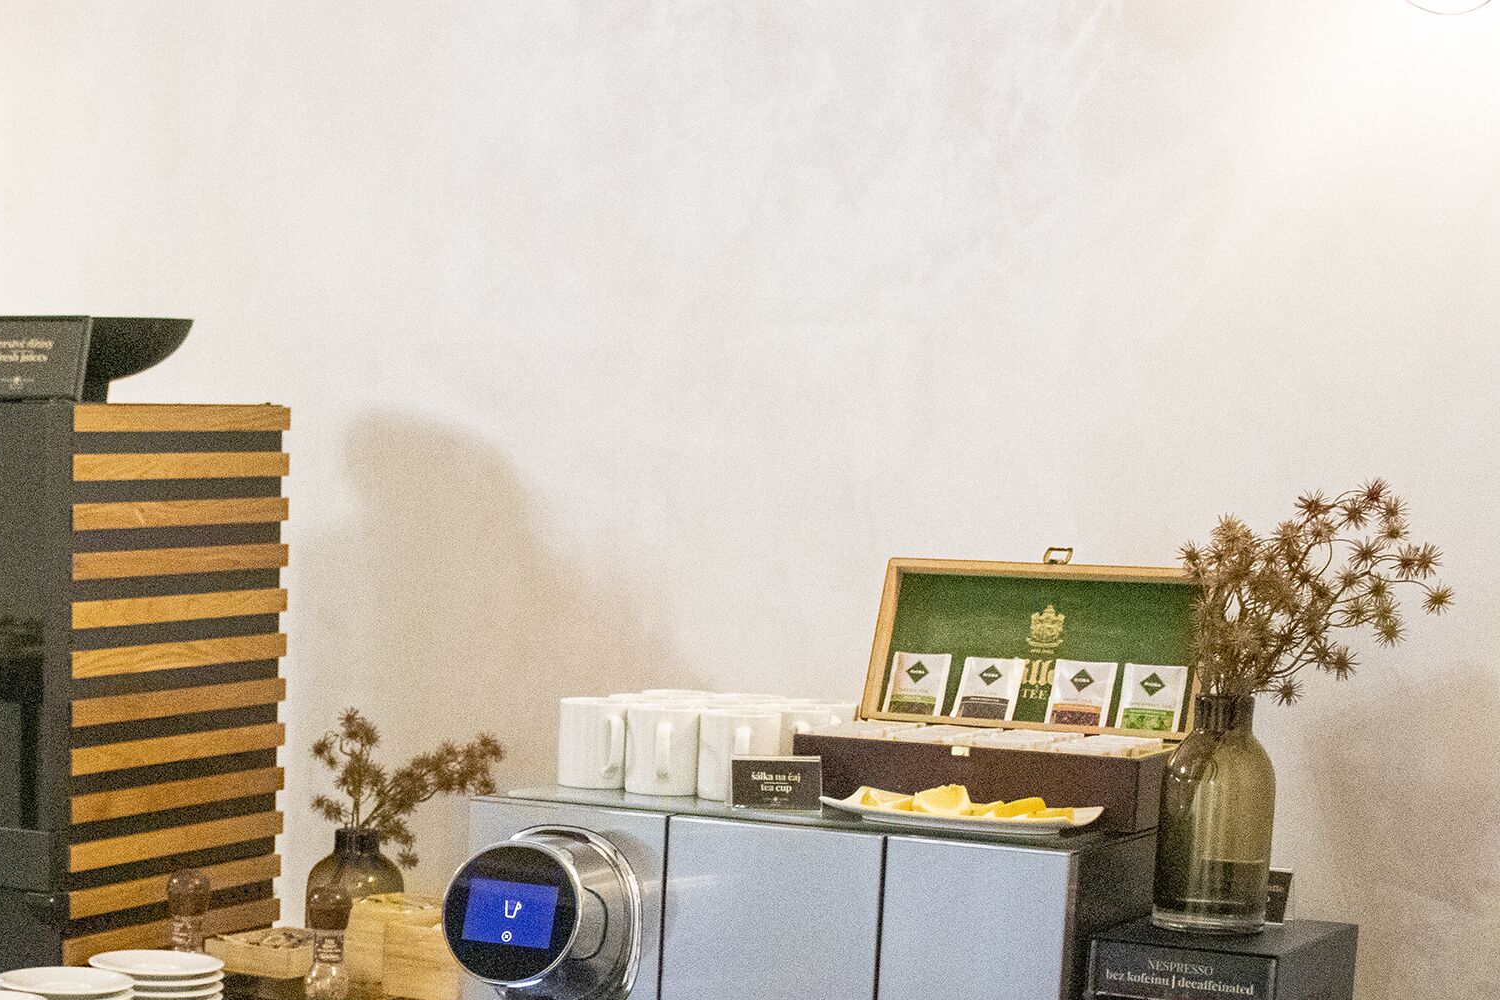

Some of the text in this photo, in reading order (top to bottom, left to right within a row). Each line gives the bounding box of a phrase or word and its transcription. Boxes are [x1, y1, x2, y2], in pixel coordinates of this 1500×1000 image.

[760, 784, 792, 794] tea cup
[1148, 960, 1214, 976] NESPRESSO
[1105, 968, 1124, 981] bez
[1177, 976, 1254, 996] decaffeinated
